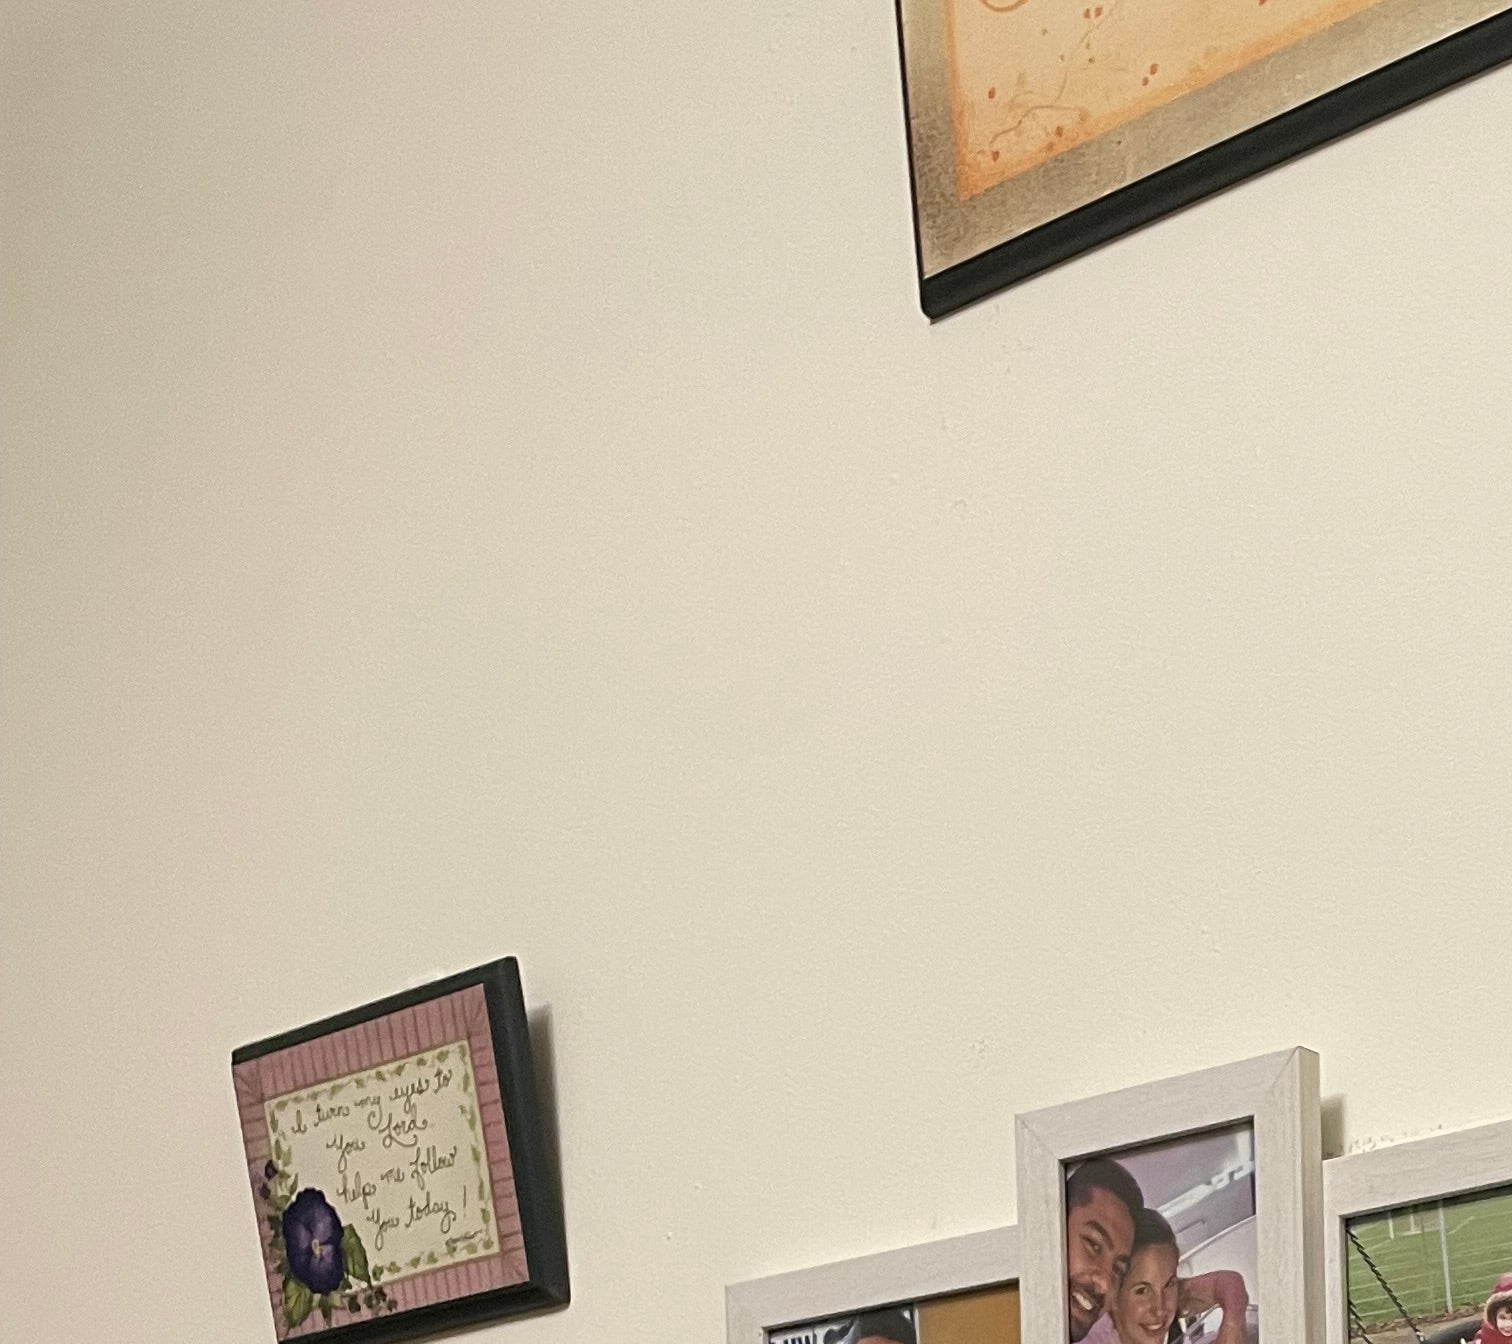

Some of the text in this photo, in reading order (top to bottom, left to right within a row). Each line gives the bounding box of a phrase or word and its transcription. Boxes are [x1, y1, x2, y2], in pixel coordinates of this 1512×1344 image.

[314, 1103, 350, 1127] turn
[354, 1094, 383, 1130] my
[389, 1077, 430, 1114] eyes
[433, 1067, 453, 1094] to
[378, 1101, 428, 1148] Lord
[336, 1145, 457, 1210] help me follow
